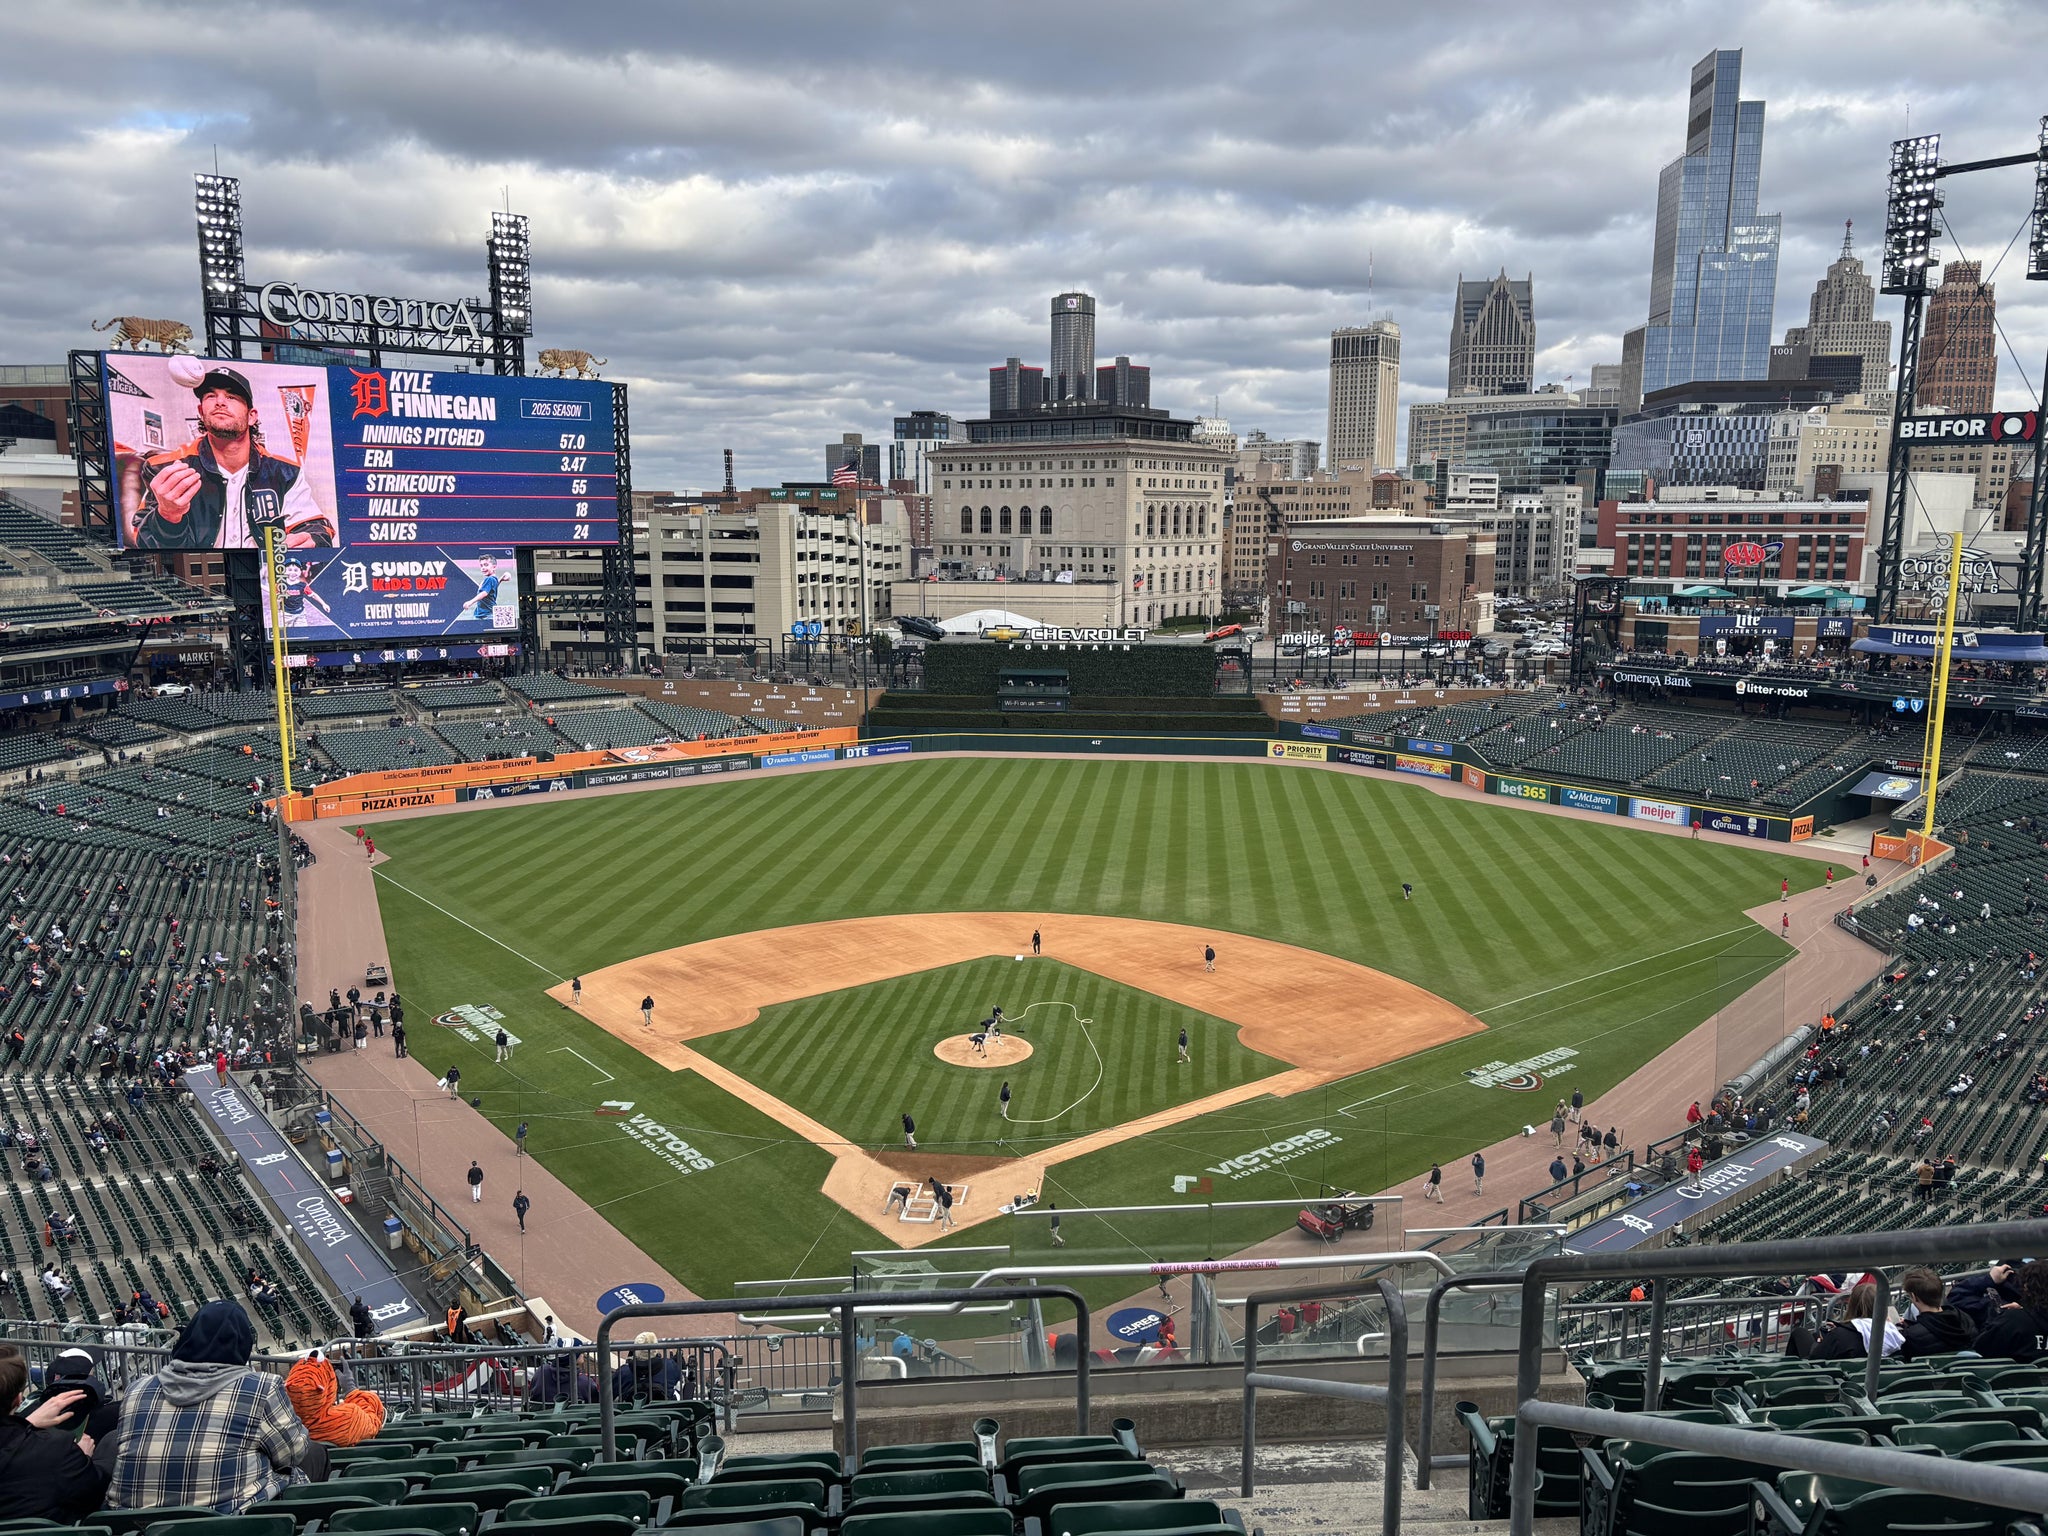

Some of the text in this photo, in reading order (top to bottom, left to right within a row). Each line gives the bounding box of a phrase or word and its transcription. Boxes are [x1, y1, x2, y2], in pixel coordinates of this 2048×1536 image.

[327, 325, 428, 347] PARK
[1773, 347, 1793, 356] 1001
[389, 371, 433, 394] KYLE
[391, 393, 496, 421] FINNEGAN
[532, 403, 582, 417] 2025 SEASON
[362, 425, 485, 447] INNINGS PITCHED
[1900, 419, 1986, 438] BELFOR
[559, 434, 586, 450] 57.0
[363, 449, 393, 468] ERA
[560, 457, 587, 472] 3.47
[366, 474, 456, 494] STRIKEOUTS
[571, 479, 588, 495] 55
[368, 498, 419, 517] WALKS
[575, 502, 589, 518] 18
[369, 523, 418, 541] SAVES
[573, 524, 590, 540] 24
[1371, 543, 1414, 551] UNIVERSITY
[1726, 546, 1764, 564] AAA
[273, 543, 290, 600] Rocket
[370, 561, 447, 576] SUNDAY
[415, 576, 448, 590] DAY
[1898, 580, 1999, 594] LANING
[1929, 551, 1950, 616] Rocket
[364, 602, 430, 620] EVERY SUNDAY
[1735, 614, 1761, 629] Lite
[1031, 628, 1149, 641] CHEVROLET
[1281, 631, 1326, 647] meijer
[1439, 631, 1471, 640] FIEGER
[1892, 631, 1958, 646] Lite LOUNE
[1450, 640, 1470, 648] LAW
[179, 651, 214, 663] MARKET
[334, 685, 386, 693] CHEVROLET
[425, 680, 474, 688] CHEVROLET
[737, 683, 743, 691] 5
[1664, 675, 1692, 688] Bank
[734, 738, 758, 746] DELIVERY
[796, 732, 820, 740] DELIVERY
[846, 747, 869, 758] DTE
[1286, 745, 1322, 754] PRIORITY
[1350, 752, 1375, 760] DETROIT
[502, 760, 532, 769] DELIVERY
[774, 756, 796, 764] FANDUEL
[1400, 759, 1430, 772] Surfside
[421, 768, 452, 778] DELIVERY
[595, 773, 628, 784] BETMGM
[637, 769, 669, 780] BETMGM
[1500, 781, 1547, 800] bet365
[1870, 790, 1903, 799] LOTTERY
[361, 794, 435, 811] PIZZA! PIZZA!
[1578, 792, 1612, 806] McLaren
[1641, 804, 1676, 819] meijer
[1711, 819, 1742, 831] Corona
[1793, 823, 1813, 836] PIZZA!
[1541, 1063, 1578, 1078] Adobe
[208, 1100, 227, 1118] PARK
[616, 1121, 692, 1175] HOME SOLUTIONS
[629, 1113, 715, 1170] VICTORS
[1205, 1129, 1332, 1175] VICTORS
[1230, 1136, 1343, 1180] HOME SOLUTIONS
[1713, 1177, 1747, 1196] PARK
[294, 1214, 316, 1239] PARK
[1151, 1265, 1159, 1273] DO
